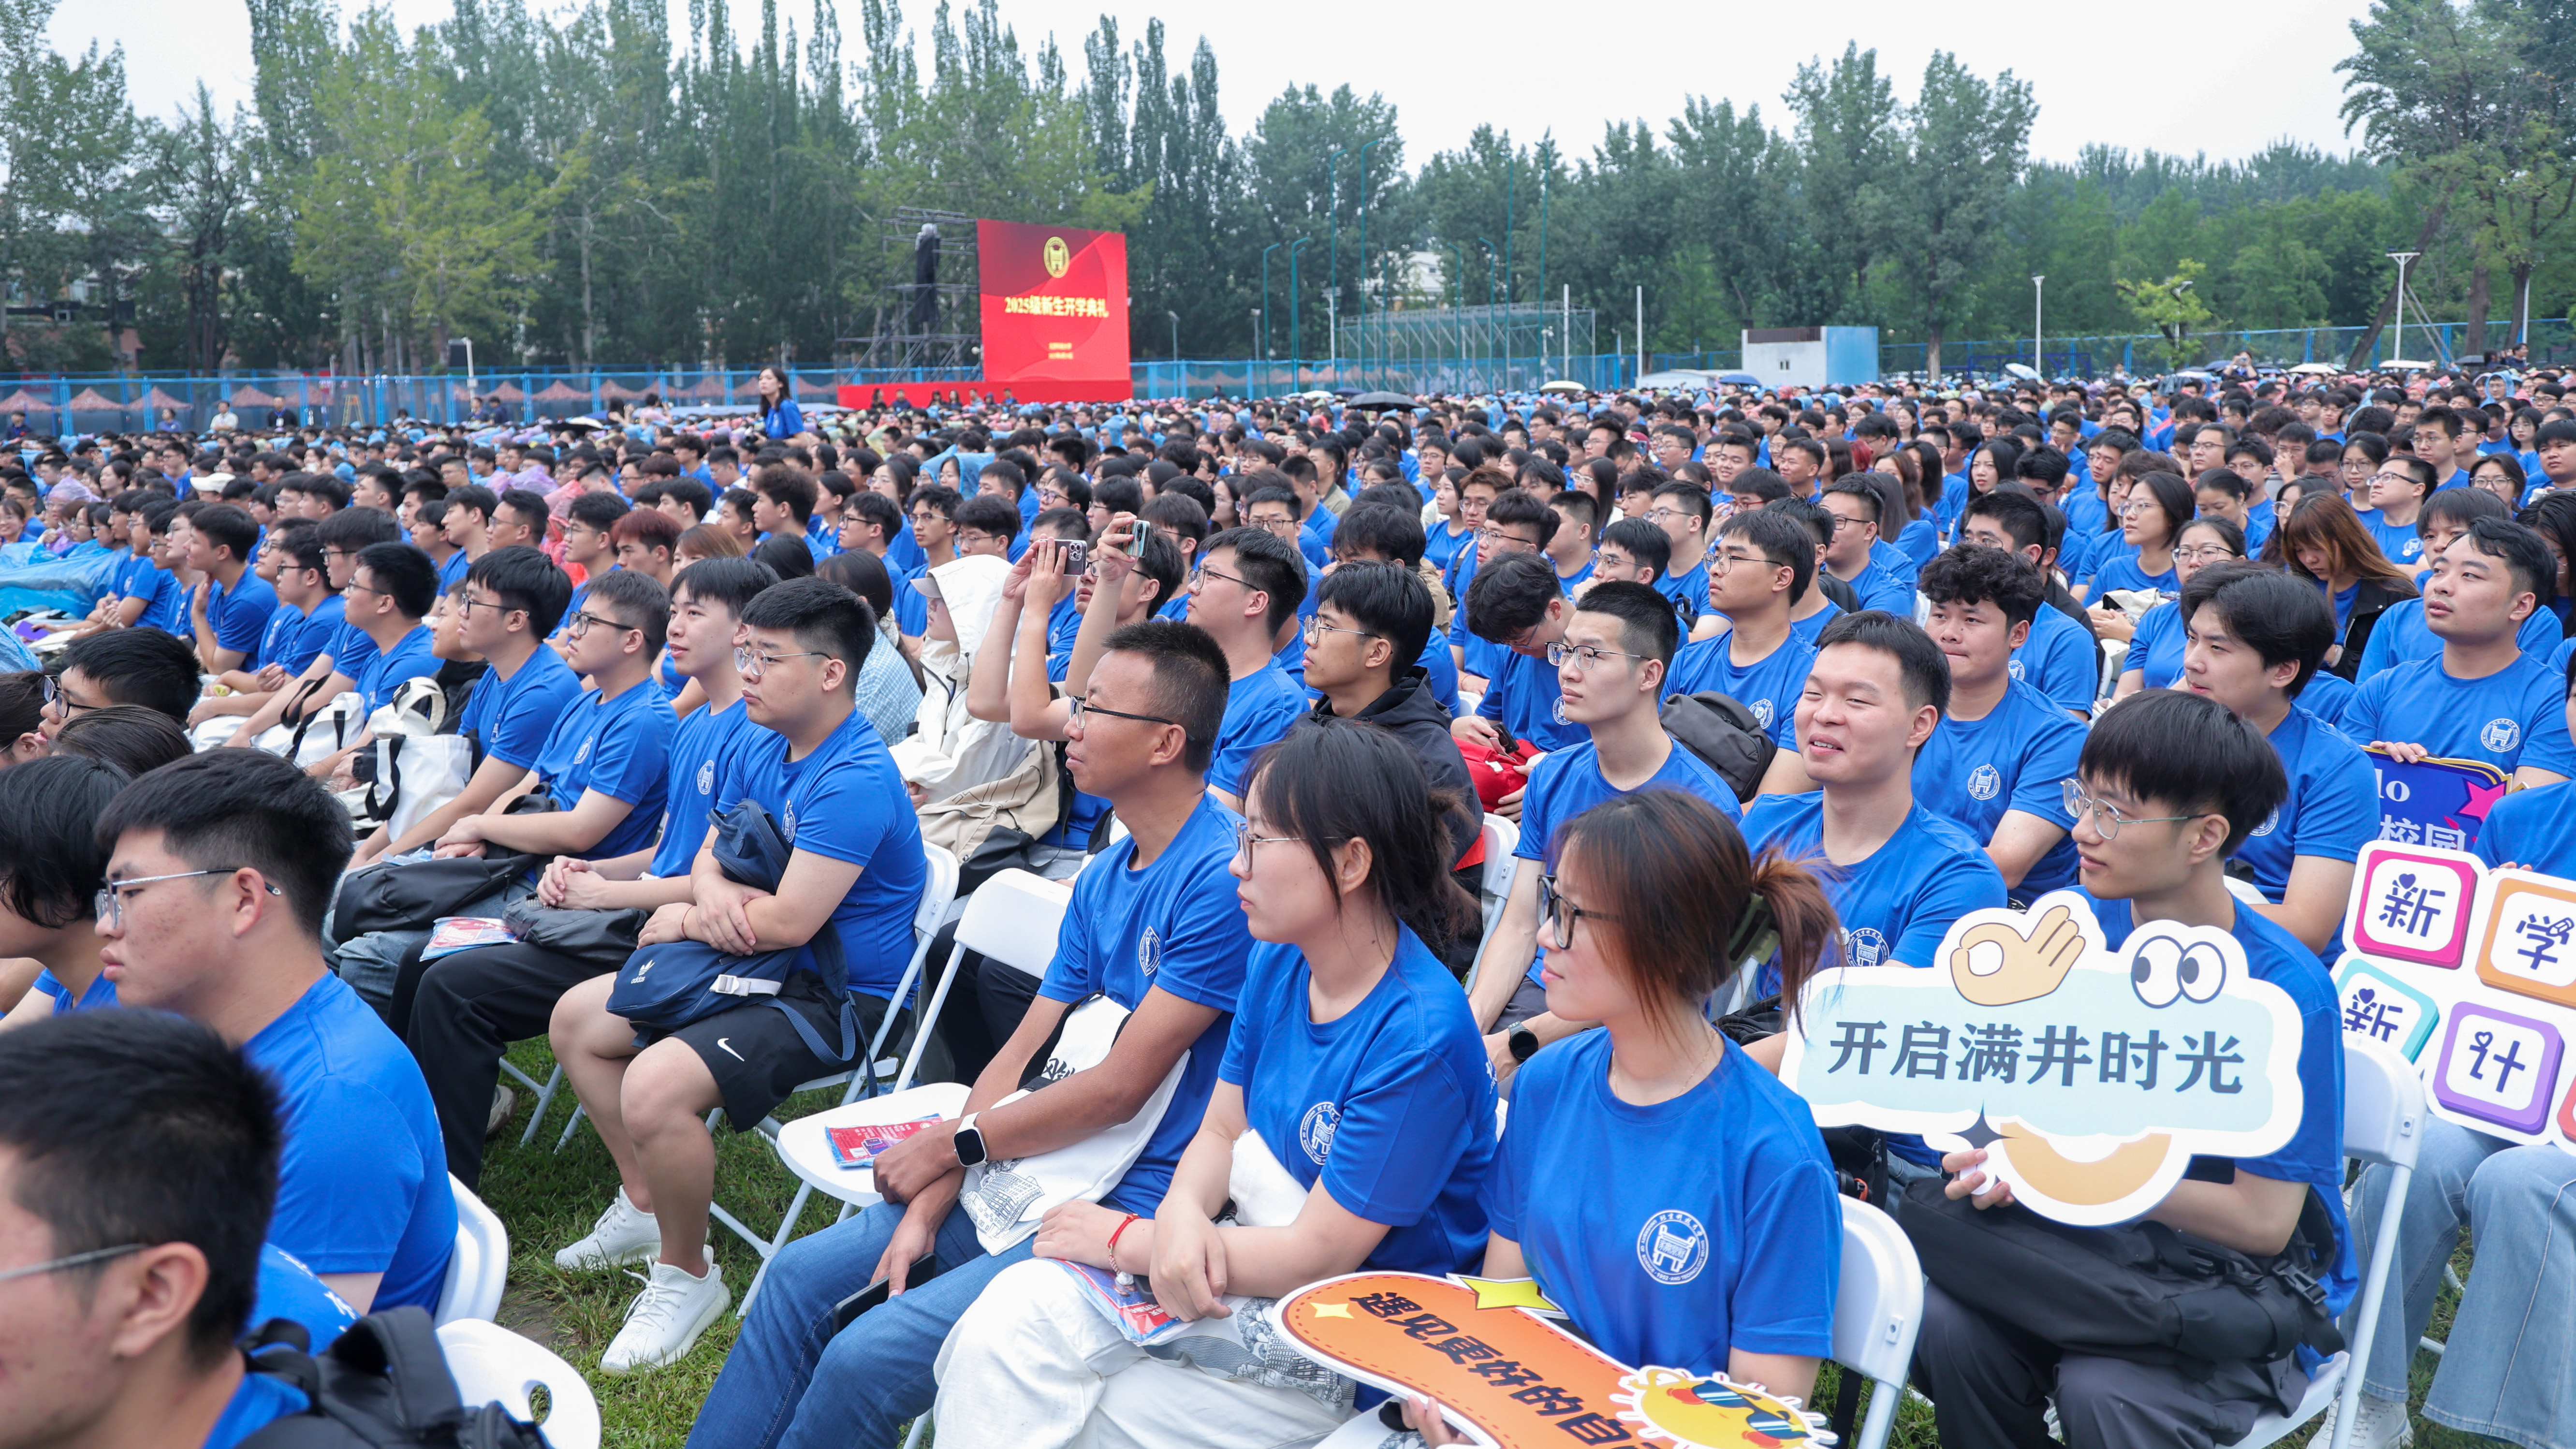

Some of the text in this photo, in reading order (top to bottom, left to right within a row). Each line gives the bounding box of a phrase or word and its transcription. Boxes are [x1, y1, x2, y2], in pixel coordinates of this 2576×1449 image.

[1005, 295, 1109, 318] 2025级新生开学典礼
[2377, 814, 2467, 852] 校园
[2378, 873, 2575, 970] 新 学
[630, 976, 646, 984] adidas
[1828, 1020, 2245, 1095] 开启满井时光
[2342, 988, 2526, 1094] 新 计
[1349, 1290, 1663, 1449] 遇见更好的自
